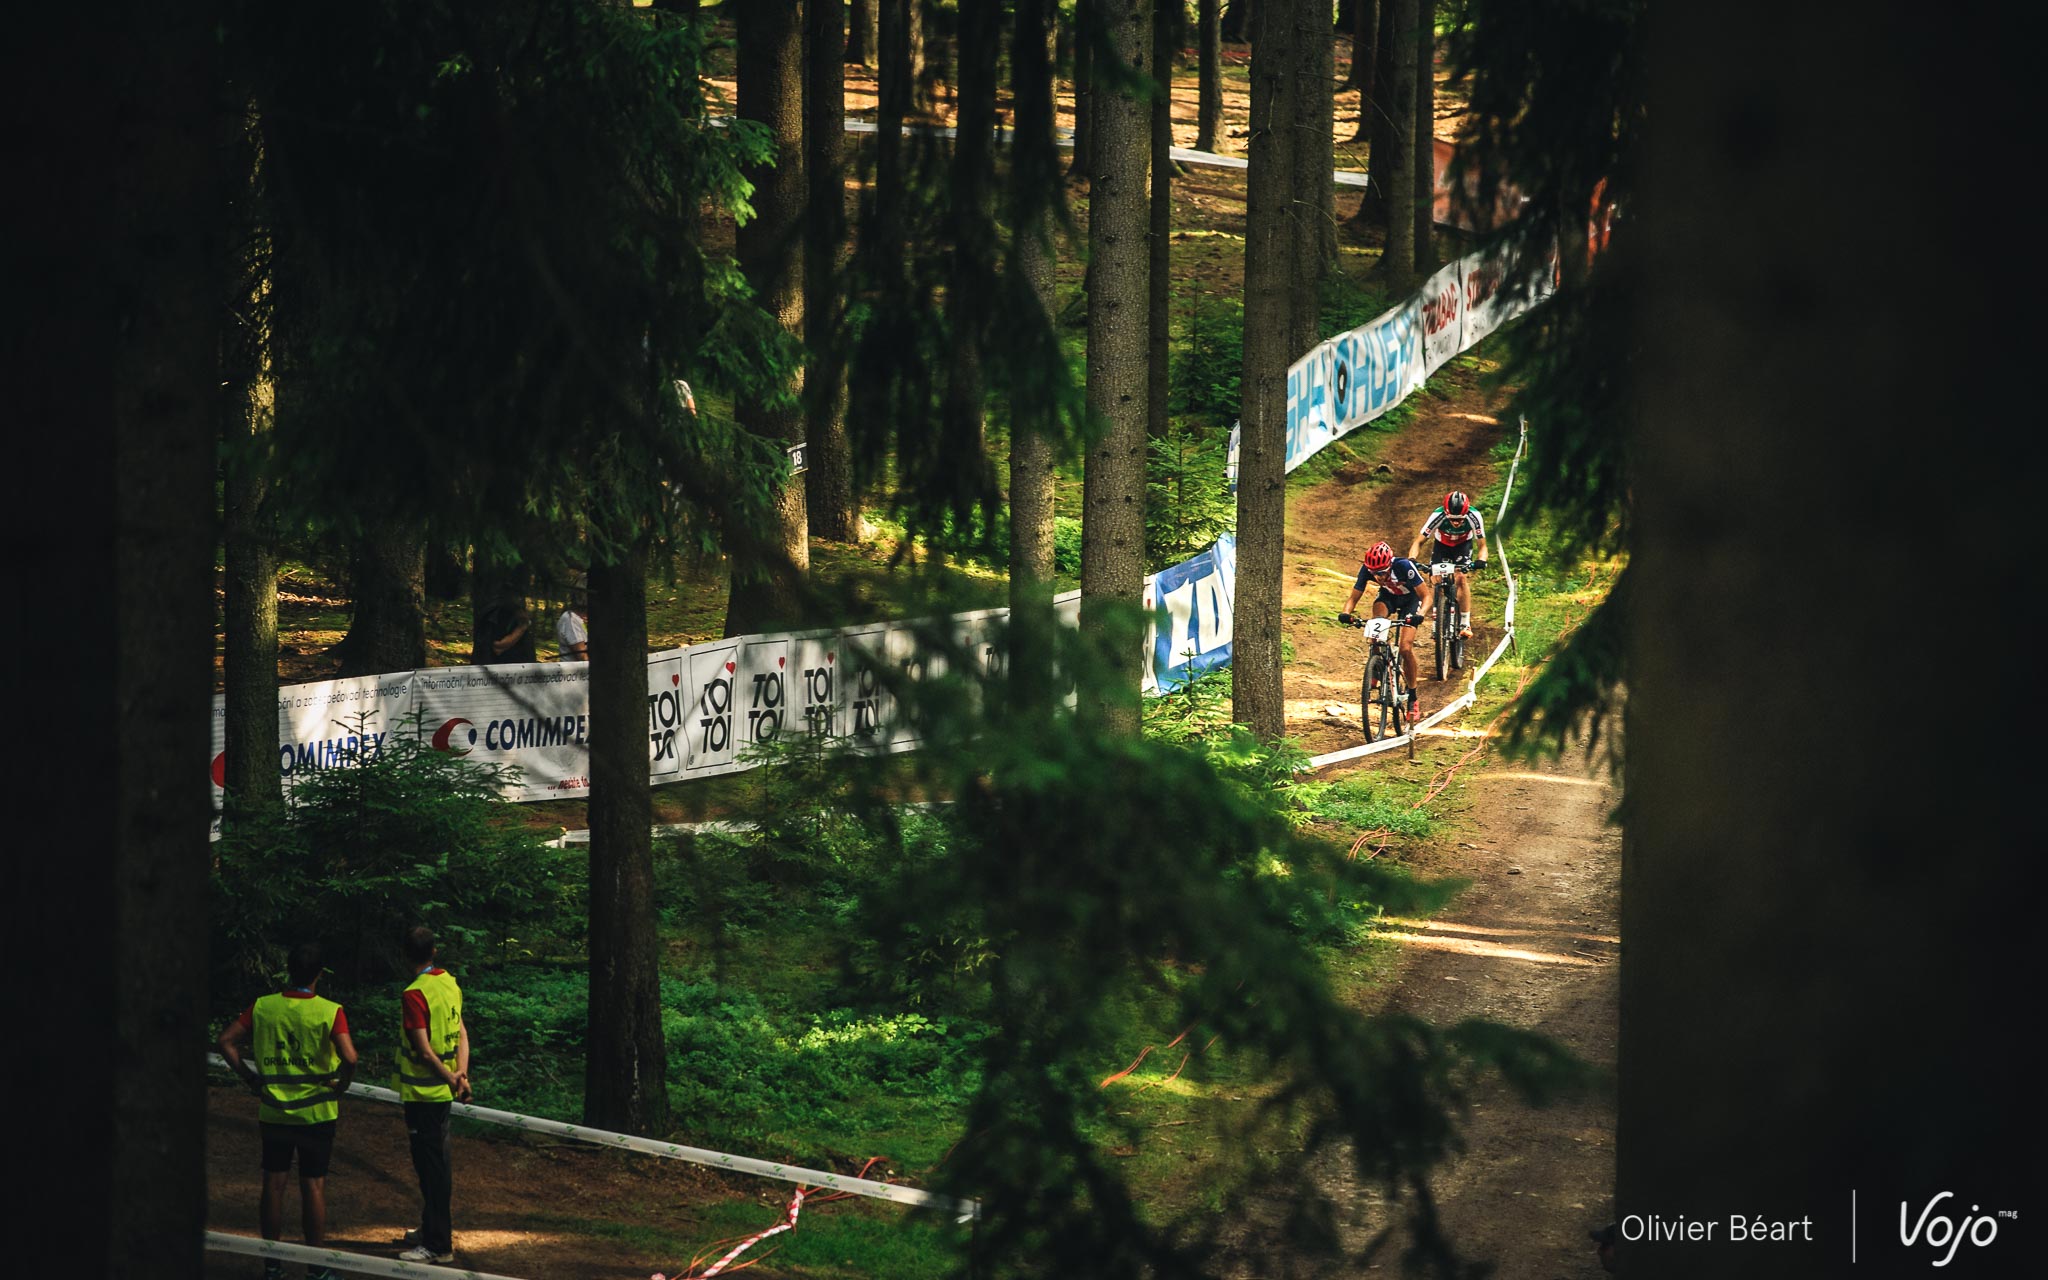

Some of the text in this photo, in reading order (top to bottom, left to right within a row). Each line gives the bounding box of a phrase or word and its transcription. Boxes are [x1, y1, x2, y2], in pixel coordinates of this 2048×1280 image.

[792, 450, 802, 466] 18
[1374, 622, 1381, 633] 2
[752, 671, 785, 709] TOI
[804, 666, 833, 704] TOI
[647, 689, 682, 731] TOI
[748, 708, 784, 745] TOI
[804, 704, 833, 739] TOI
[485, 714, 590, 751] COMIMPE
[700, 715, 732, 754] TOI
[280, 731, 388, 777] OMIMPEX
